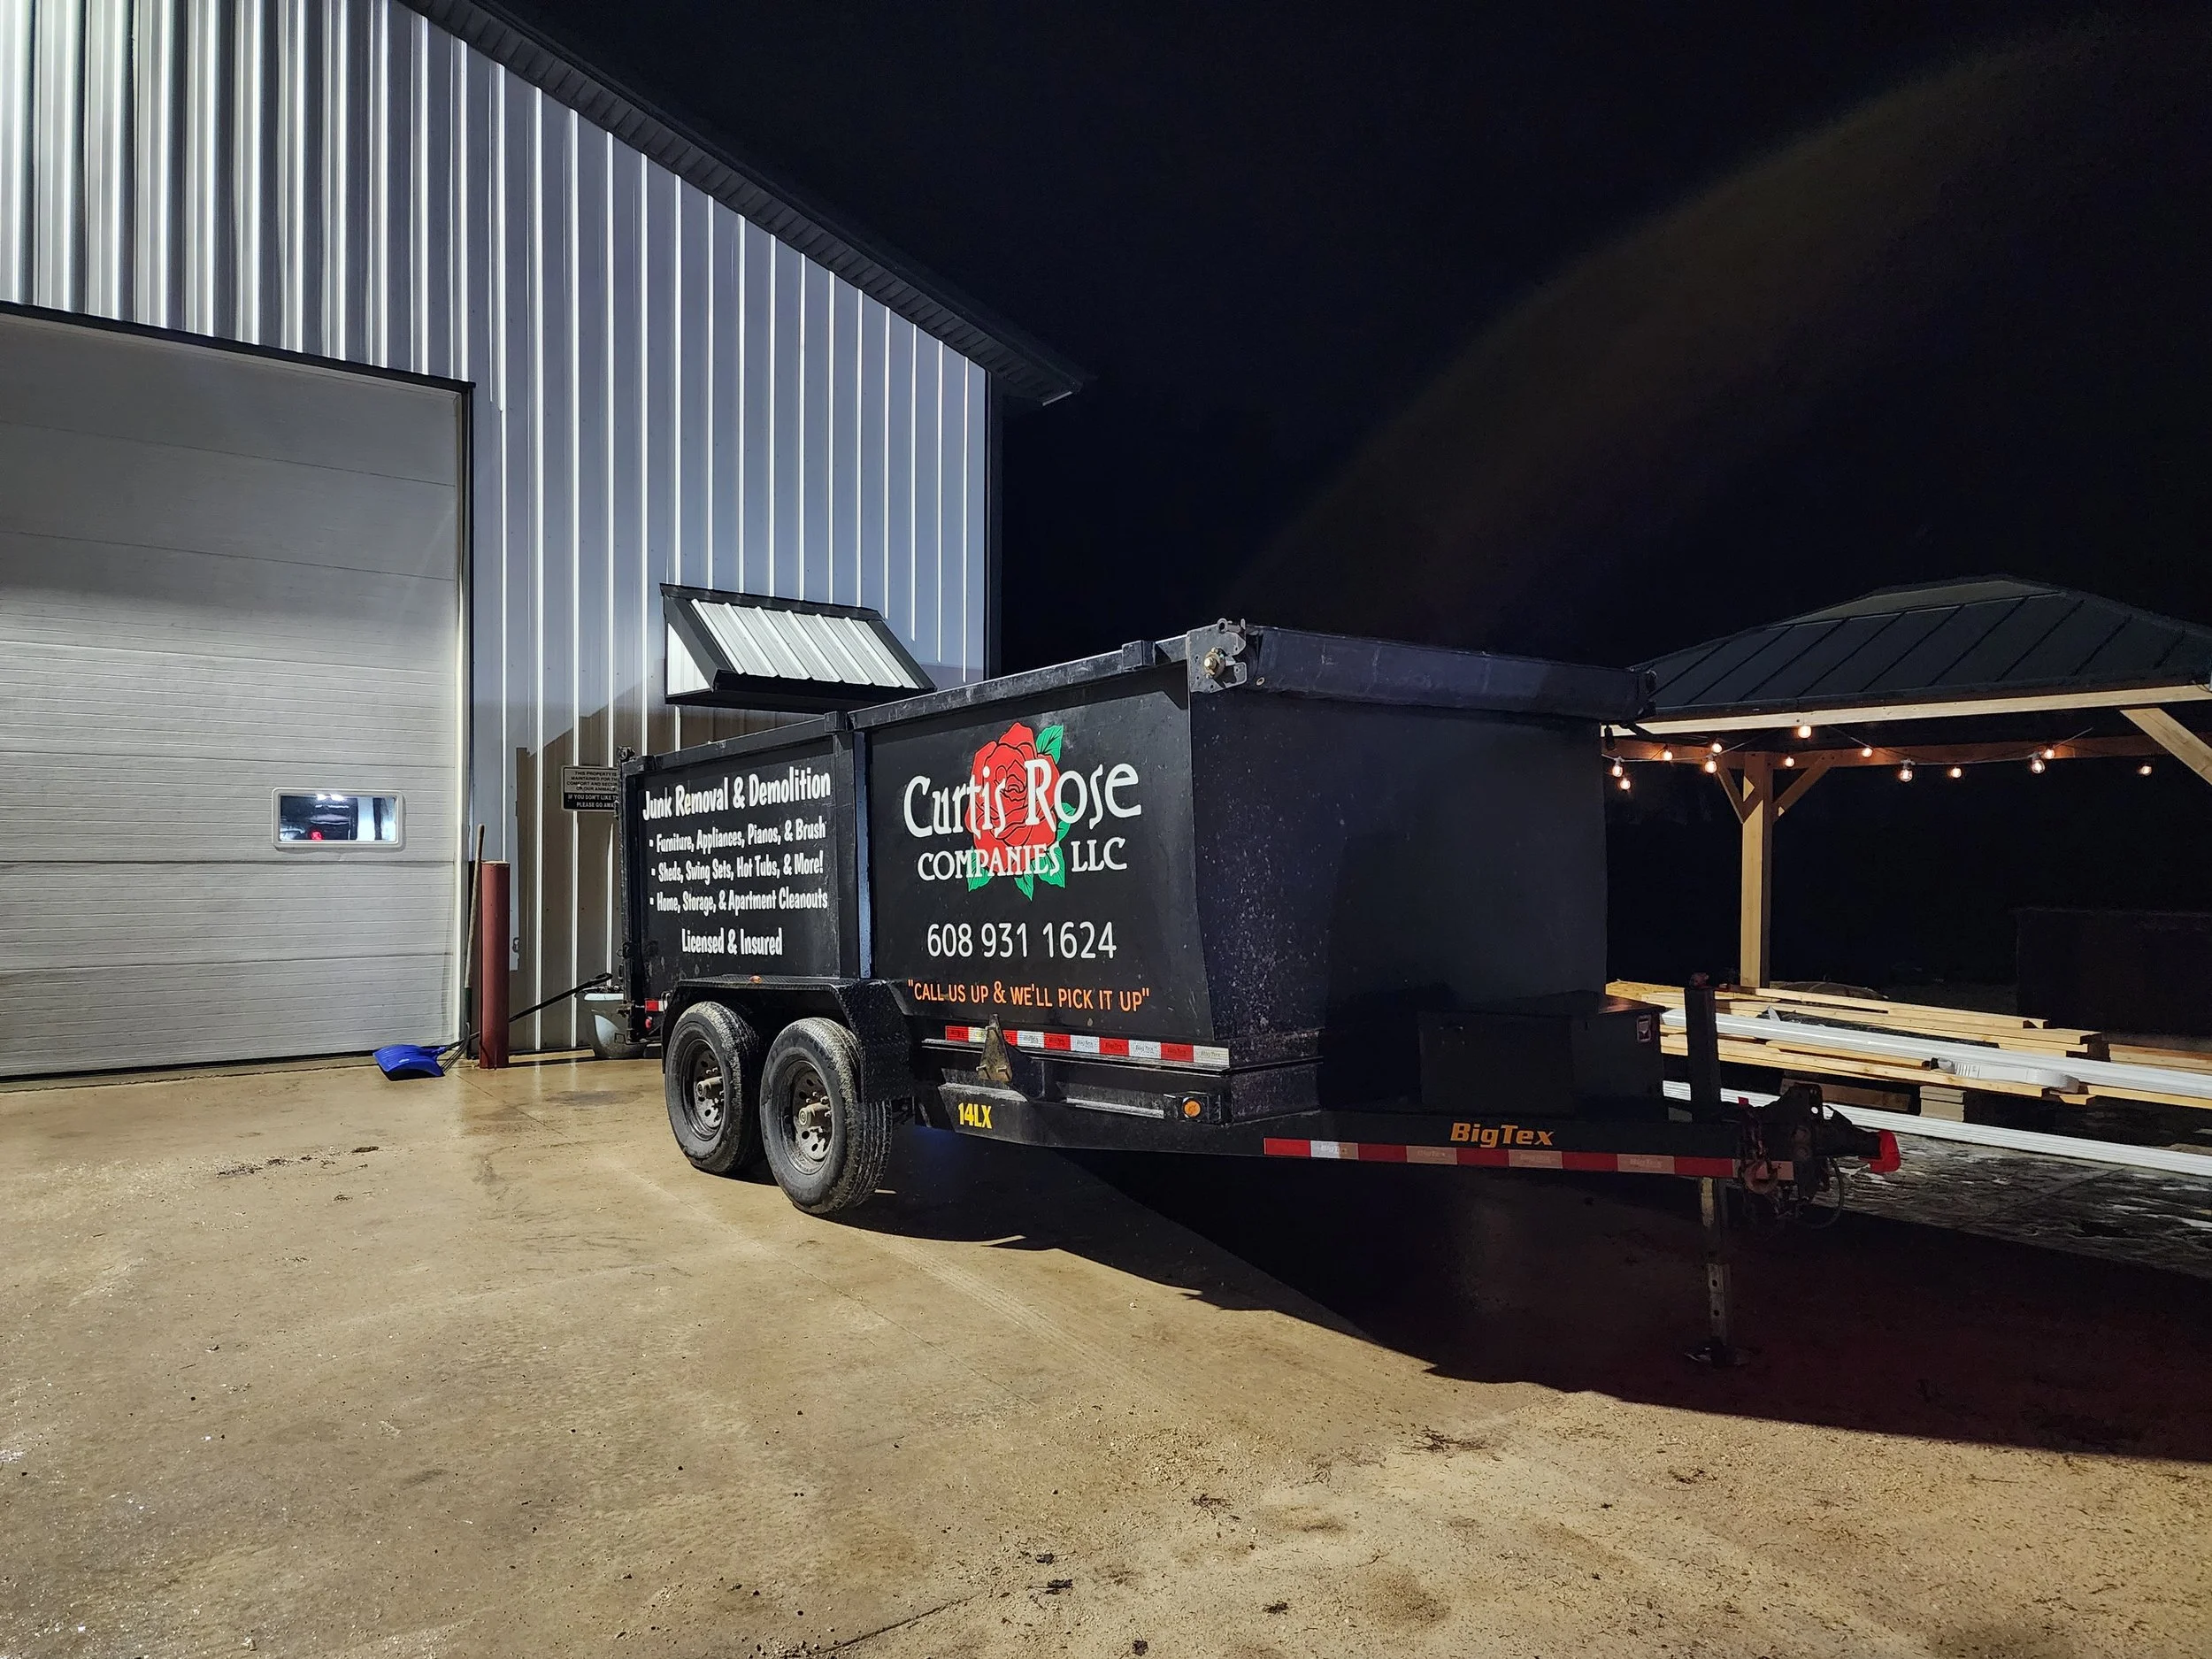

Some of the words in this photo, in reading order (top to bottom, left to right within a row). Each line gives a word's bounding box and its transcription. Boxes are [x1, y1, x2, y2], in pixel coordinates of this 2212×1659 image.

[642, 787, 672, 820] Junk
[675, 777, 729, 817] Removal
[733, 776, 745, 810] &
[749, 766, 831, 807] Demolition
[903, 766, 1006, 840] Curtis
[1024, 758, 1141, 832] Rose
[657, 833, 695, 853] Furniture,
[696, 826, 745, 855] Appliances,
[748, 823, 781, 846] Pianos,
[784, 819, 794, 841] &
[795, 815, 826, 841] Brush
[657, 860, 684, 883] Sheds,
[685, 860, 710, 886] Swing
[712, 857, 734, 881] Sets,
[736, 856, 753, 879] Hot
[754, 854, 780, 879] Tubs,
[783, 853, 793, 876] &
[794, 849, 824, 875] More!
[918, 841, 1061, 881] COMPANIES
[1071, 836, 1128, 872] LLC
[657, 891, 680, 914] Home,
[682, 890, 717, 917] Storage,
[718, 889, 727, 911] &
[727, 889, 777, 916] Apartment
[779, 886, 828, 910] Cleanouts
[681, 927, 725, 954] Licensed
[727, 928, 738, 956] &
[740, 927, 783, 956] Insured
[927, 923, 973, 958] 608
[981, 922, 1028, 958] 931
[1042, 921, 1118, 959] 1624
[908, 979, 945, 1002] "CALL
[949, 983, 966, 1003] US
[971, 984, 989, 1004] UP
[993, 980, 1006, 1004] &
[1010, 983, 1053, 1008] WE'LL
[1058, 988, 1094, 1010] PICK
[1099, 990, 1113, 1011] IT
[1120, 987, 1150, 1012] UP"
[957, 1102, 993, 1130] 14LX
[1449, 1122, 1555, 1148] BigTex
